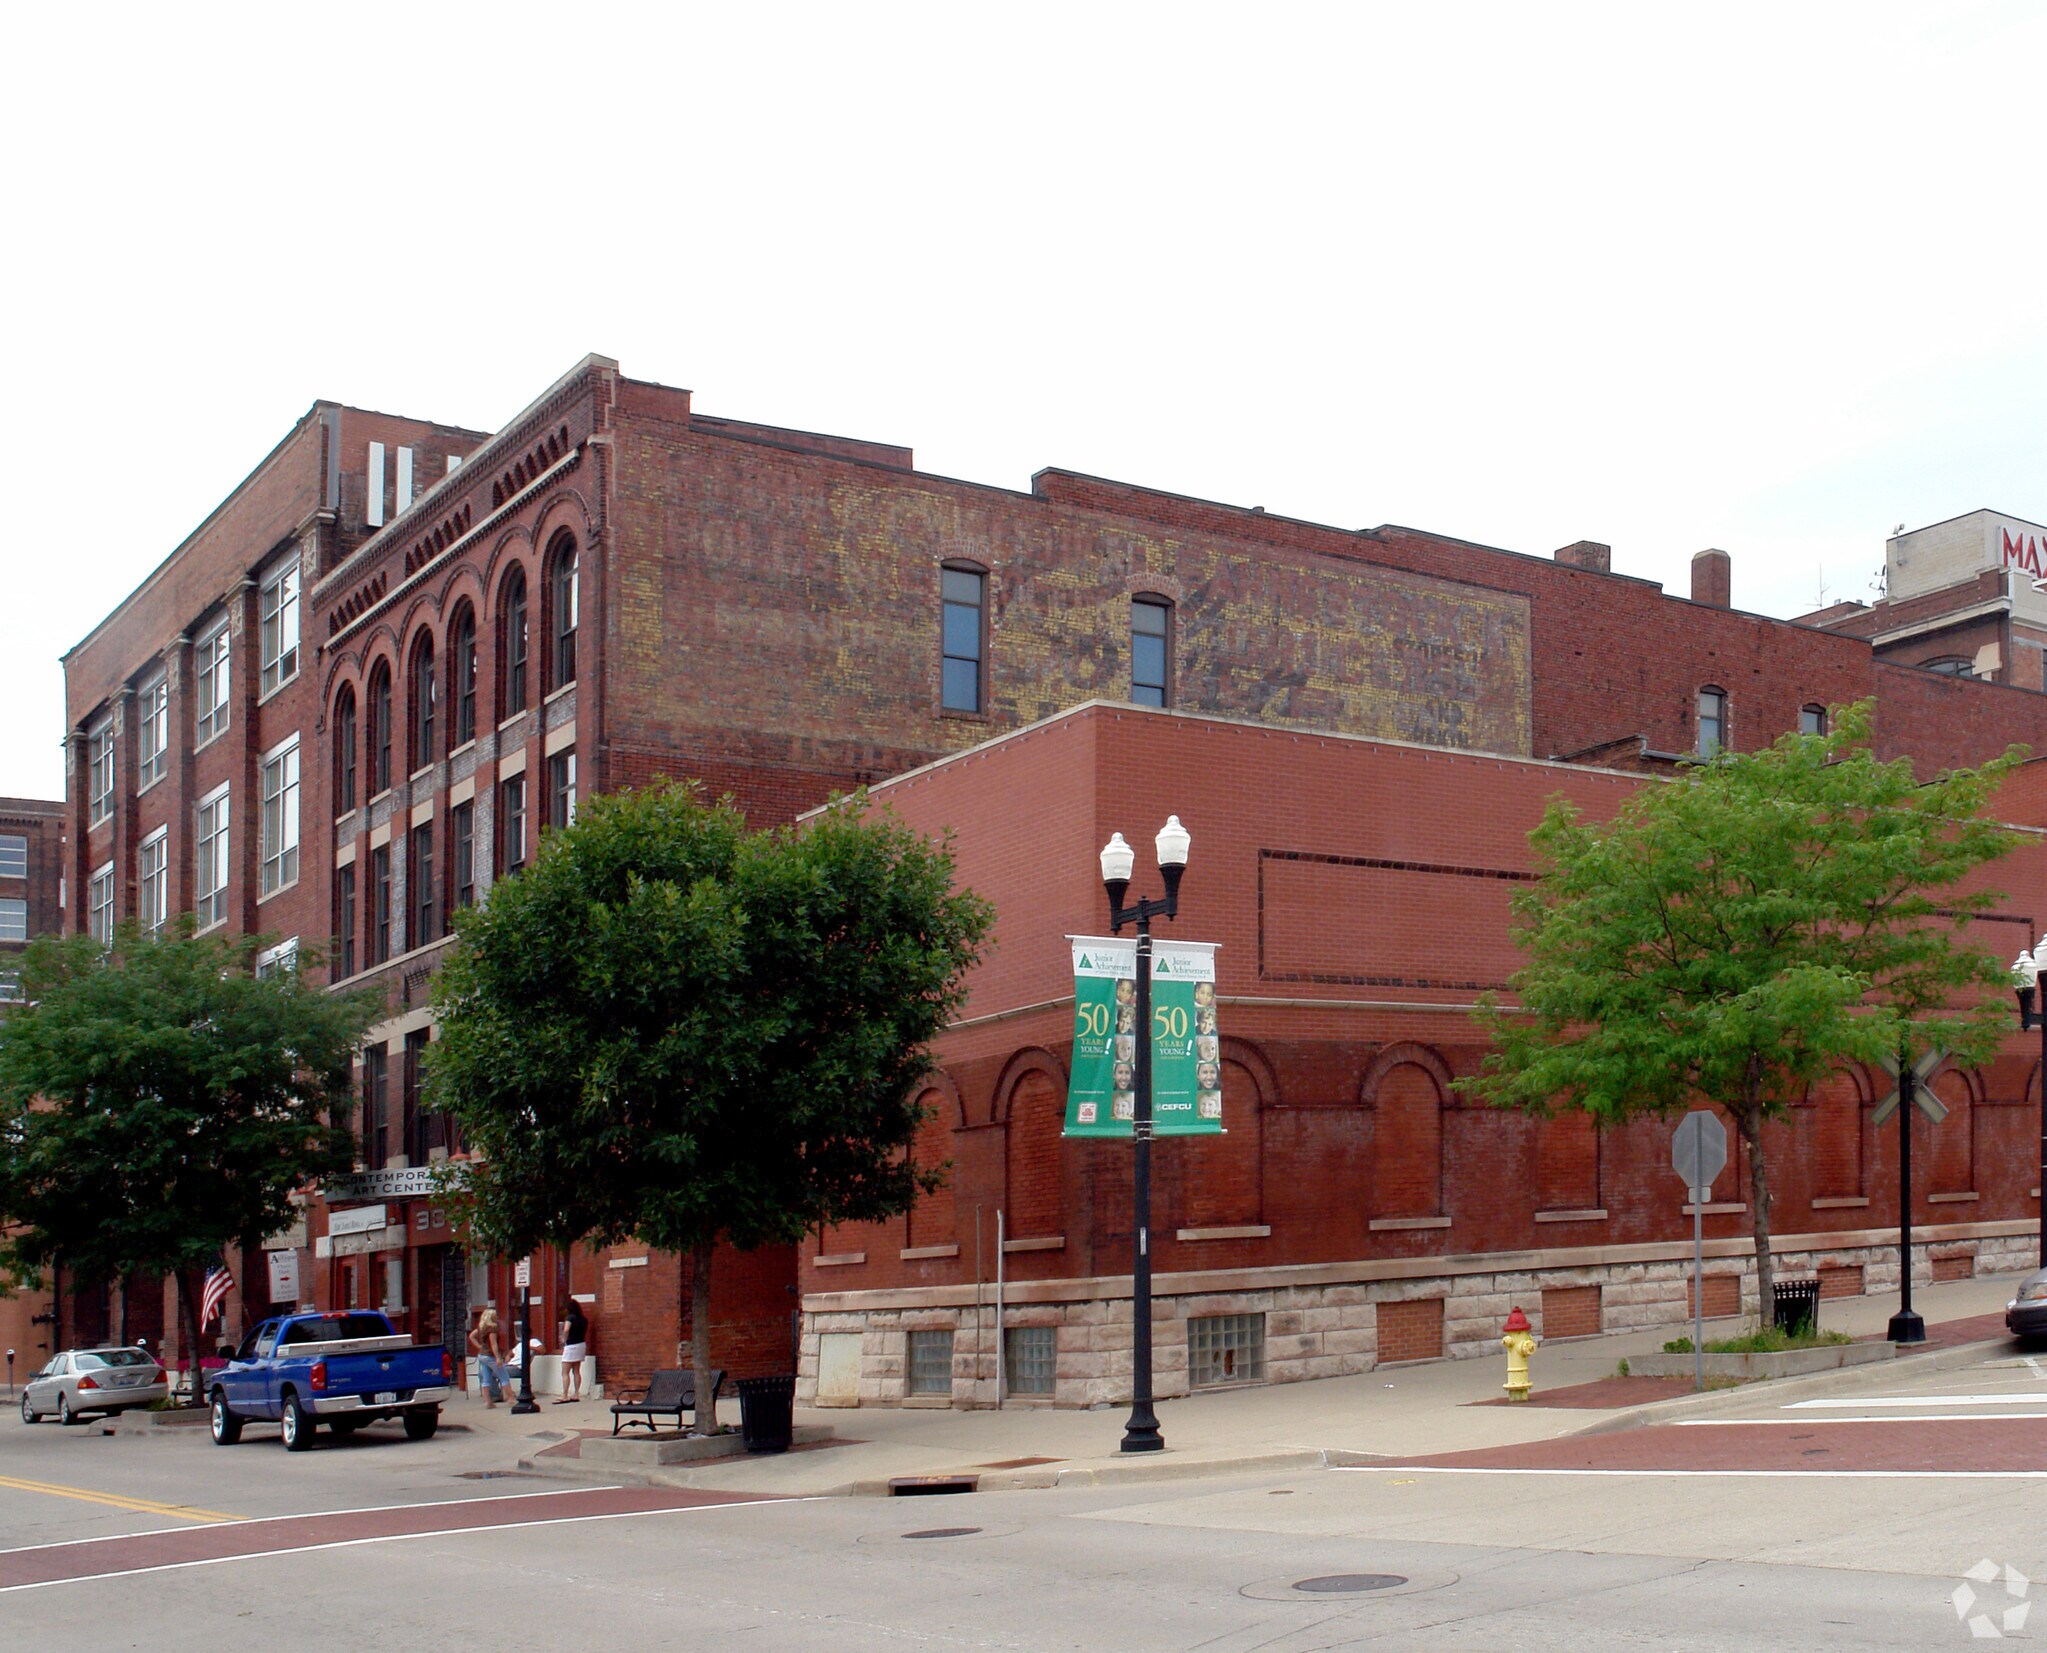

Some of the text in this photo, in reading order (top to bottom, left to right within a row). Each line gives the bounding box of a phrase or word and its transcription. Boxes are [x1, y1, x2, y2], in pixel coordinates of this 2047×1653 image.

[1094, 953, 1113, 961] Junior
[1172, 957, 1191, 965] Junior
[1094, 962, 1132, 971] Achievement
[1172, 966, 1211, 975] Achievement
[1077, 1003, 1109, 1037] 50
[1154, 1006, 1188, 1040] 50
[343, 1171, 426, 1185] CONTEMPOR
[353, 1185, 376, 1196] ART
